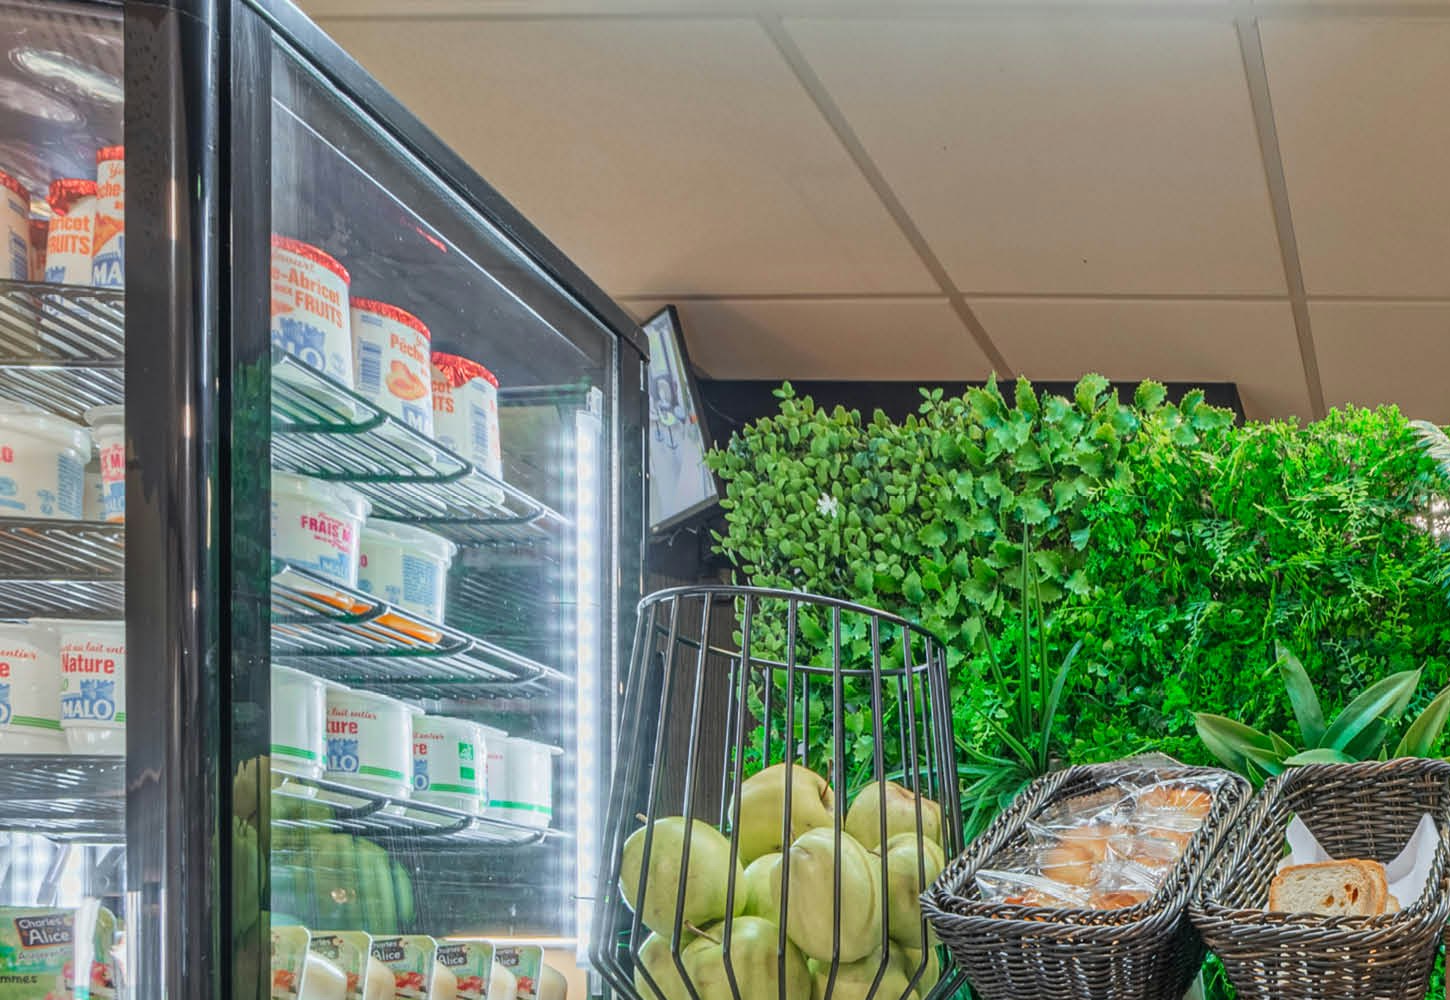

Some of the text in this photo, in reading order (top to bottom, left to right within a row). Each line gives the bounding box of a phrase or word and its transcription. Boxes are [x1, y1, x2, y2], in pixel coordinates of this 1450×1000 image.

[271, 267, 340, 306] e-Abricot
[295, 290, 343, 328] FRUITS
[301, 515, 339, 538] FRAIS
[63, 699, 112, 719] MALO
[30, 929, 70, 945] Alice
[0, 976, 38, 985] mmes
